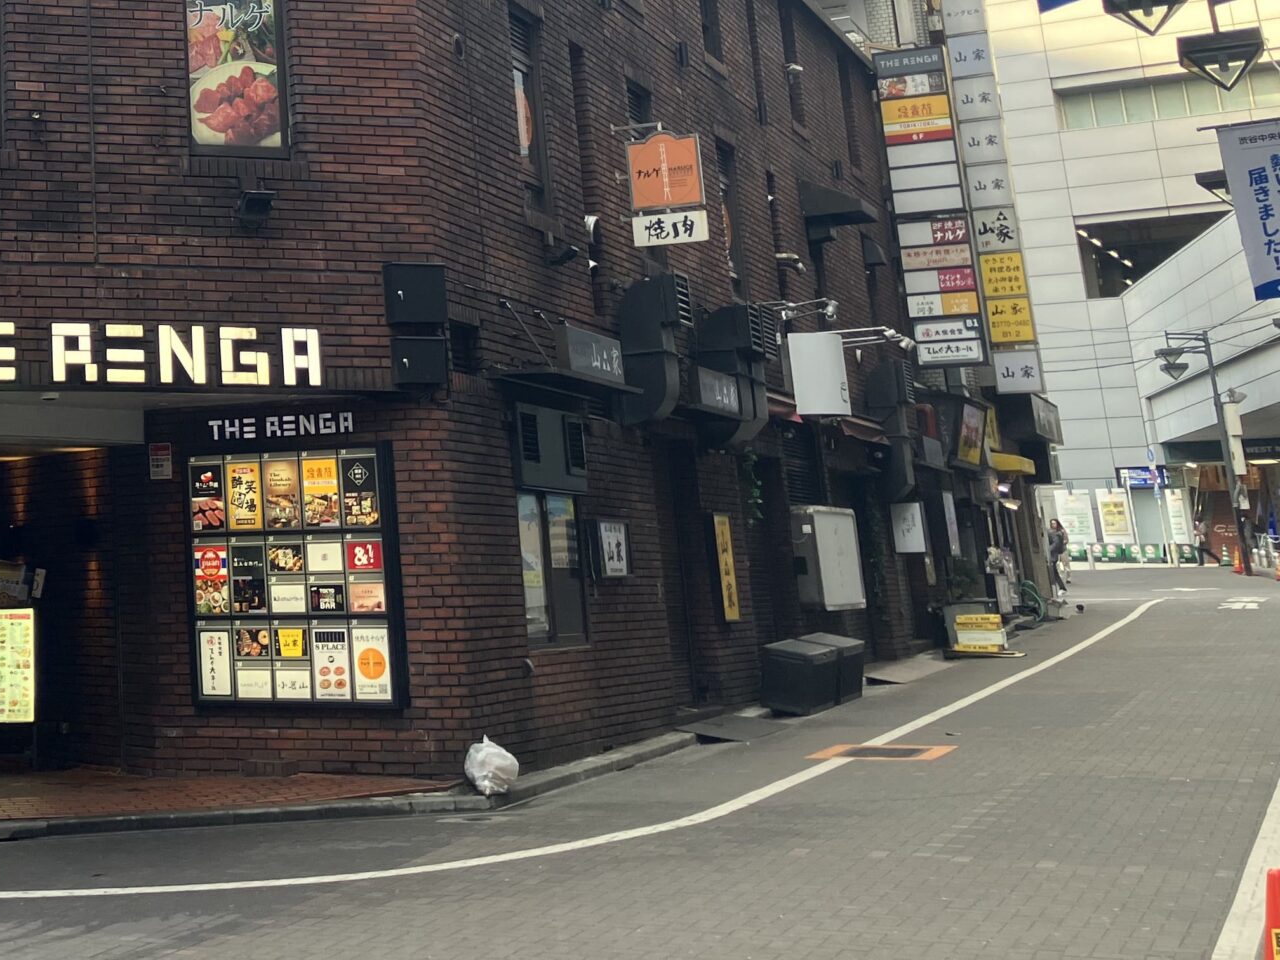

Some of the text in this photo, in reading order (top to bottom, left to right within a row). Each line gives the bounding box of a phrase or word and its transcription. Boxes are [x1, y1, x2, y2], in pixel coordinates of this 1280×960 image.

[188, 0, 272, 32] ナルゲ
[880, 54, 939, 69] THE RENGA
[955, 49, 985, 64] 山家
[961, 92, 993, 105] 山家
[968, 134, 999, 147] 山家
[1239, 132, 1280, 145] 渋谷中央
[974, 178, 1005, 191] 山家
[644, 215, 695, 243] 焼肉
[934, 229, 966, 241] ナルゲ
[978, 221, 1014, 244] 山家
[51, 322, 322, 387] RENGA
[1001, 365, 1035, 379] 山家
[208, 411, 354, 440] THE RENGA
[321, 643, 346, 651] PLACE
